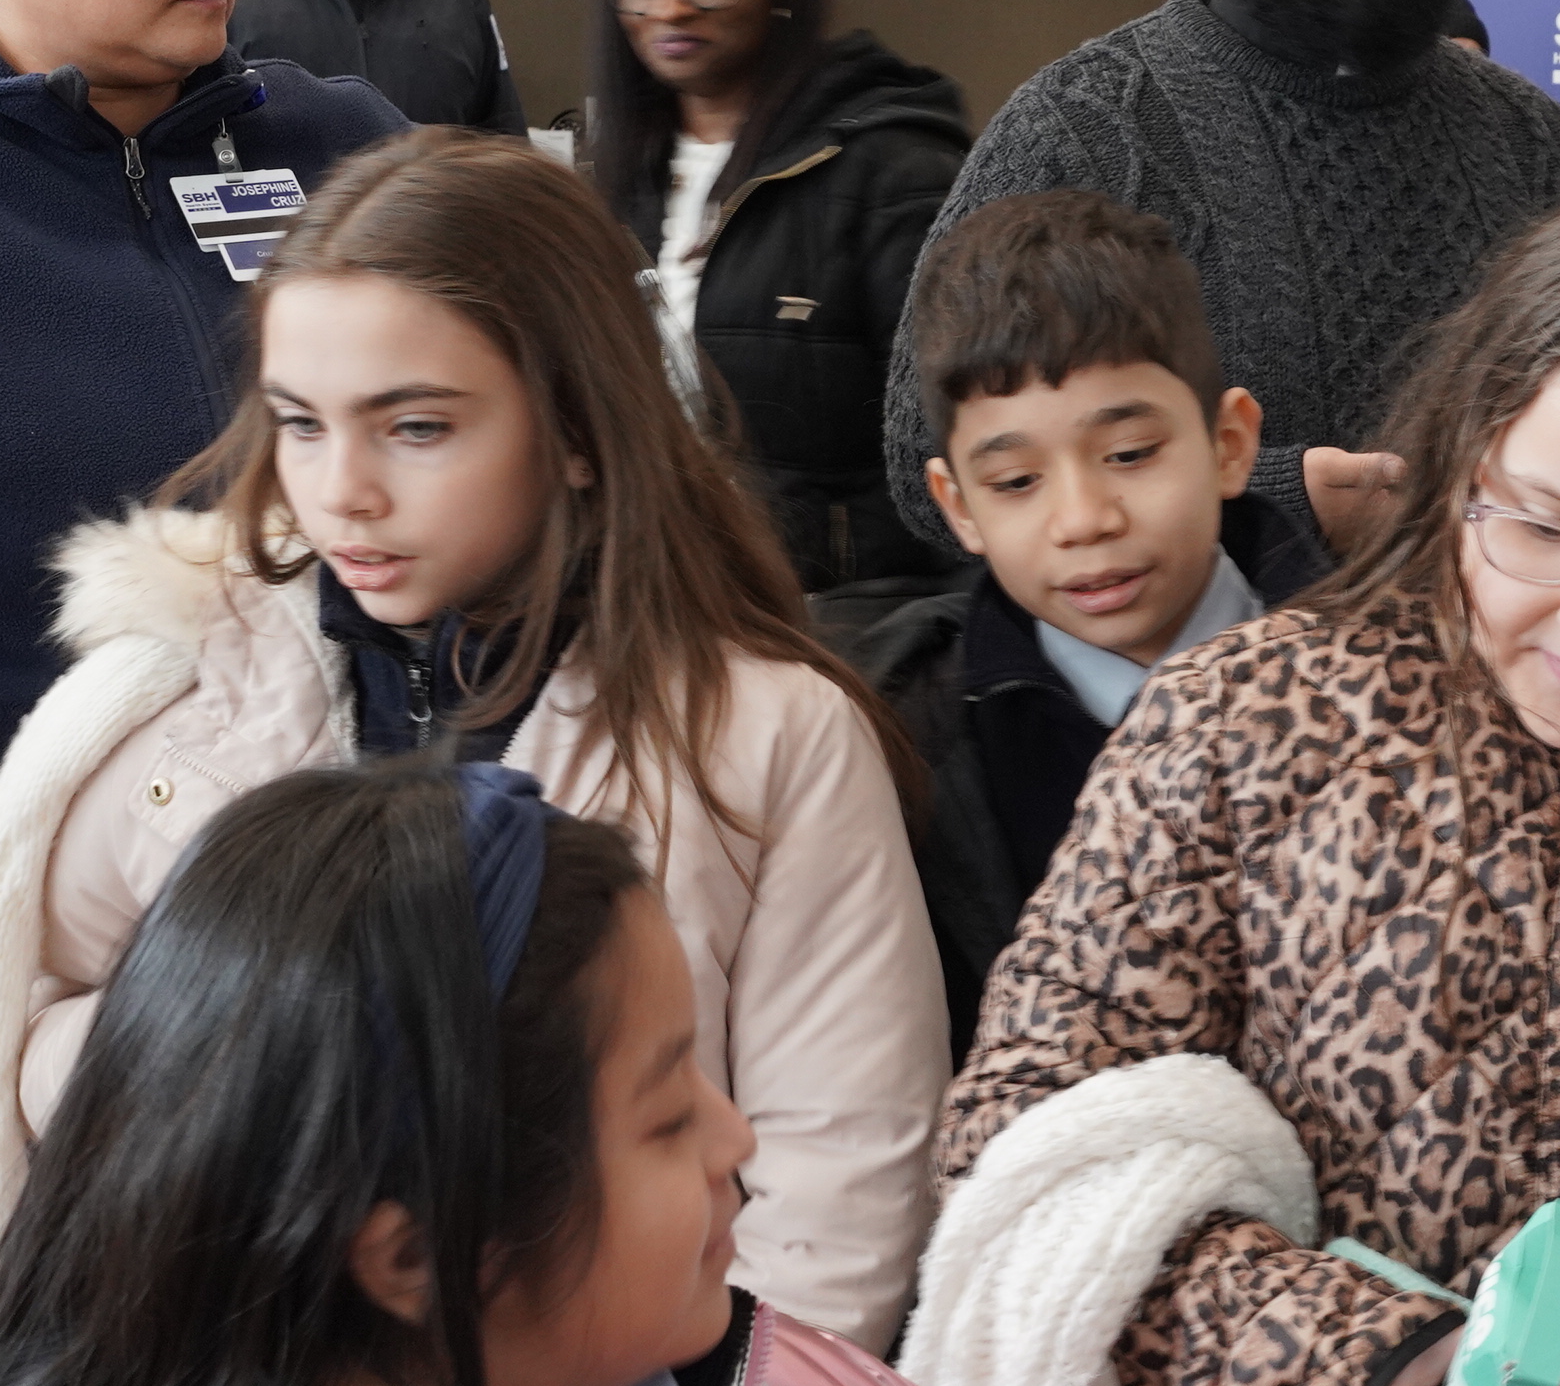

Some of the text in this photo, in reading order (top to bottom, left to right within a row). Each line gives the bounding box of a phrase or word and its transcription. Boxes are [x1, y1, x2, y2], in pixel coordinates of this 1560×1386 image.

[181, 181, 298, 204] SBH JOSEPHINE
[271, 192, 305, 208] CRUZ
